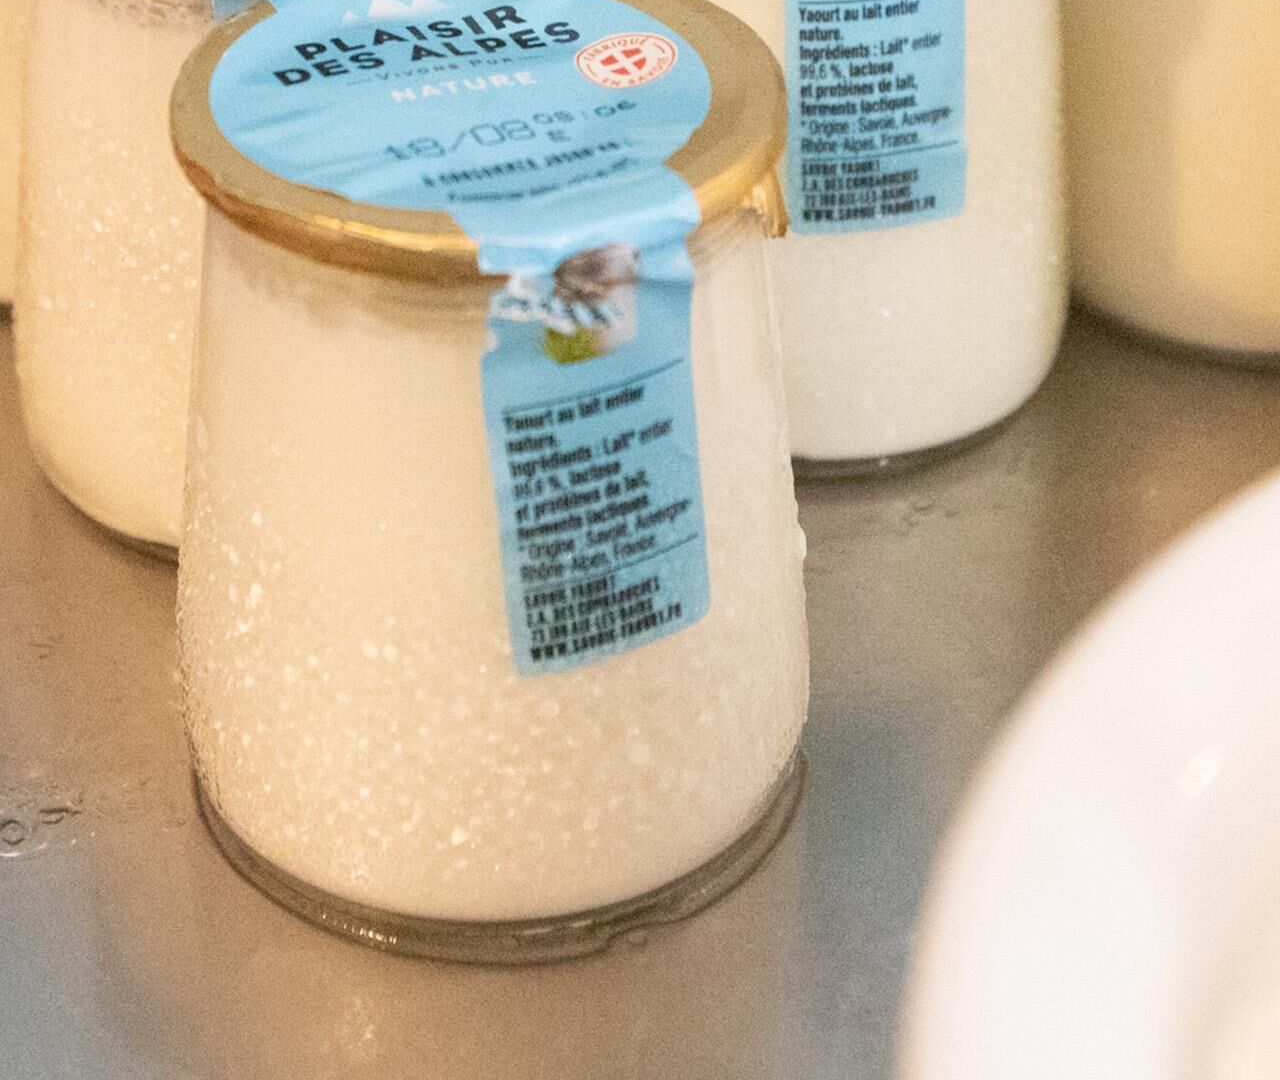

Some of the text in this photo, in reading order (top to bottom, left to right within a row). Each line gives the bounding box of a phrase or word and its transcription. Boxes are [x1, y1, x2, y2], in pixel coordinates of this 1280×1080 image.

[799, 0, 920, 23] Yaourt au lait entier
[294, 5, 526, 61] PLAISIR
[799, 27, 844, 42] nature.
[800, 42, 870, 63] Ingrédients
[911, 33, 942, 51] entier
[273, 21, 580, 86] DES ALPES
[849, 60, 894, 78] lactose
[390, 71, 538, 103] NATURE
[800, 73, 918, 101] et protéines de lait,
[800, 94, 917, 117] ferments lactiques.
[503, 410, 554, 433] Yaourt
[557, 407, 575, 423] au
[605, 385, 644, 410] entier
[510, 447, 592, 478] Ingrédients
[569, 461, 621, 485] lactose
[534, 488, 601, 520] protéines
